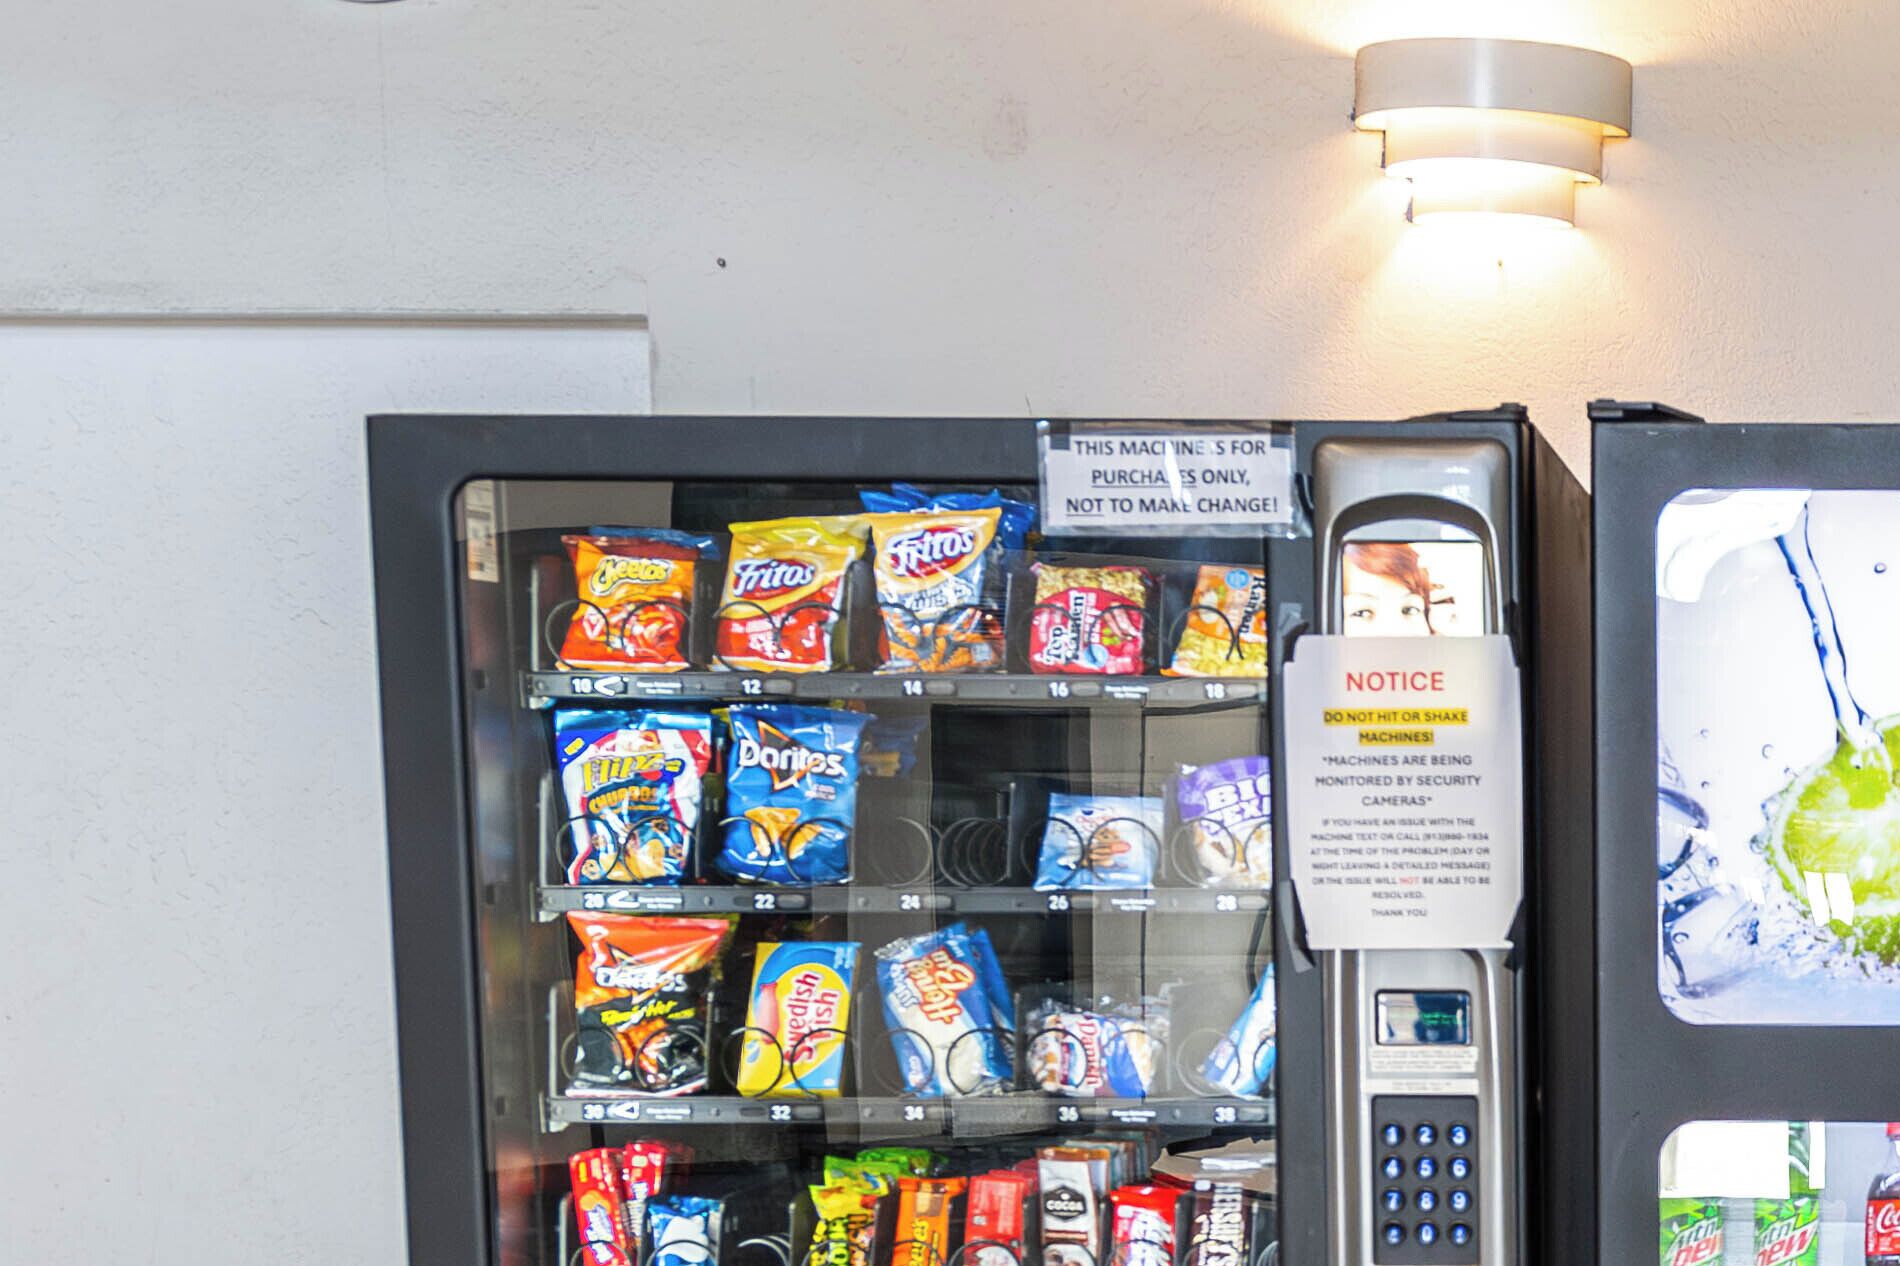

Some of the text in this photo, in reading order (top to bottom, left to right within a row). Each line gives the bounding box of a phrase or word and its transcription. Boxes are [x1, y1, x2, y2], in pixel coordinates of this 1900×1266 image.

[1075, 440, 1114, 455] THIS
[1231, 440, 1266, 455] FOR
[1092, 469, 1250, 486] PURCHAES ONLY,
[1066, 498, 1104, 513] NOT
[1111, 498, 1133, 512] TO
[1197, 498, 1278, 513] CHANGE!
[886, 527, 975, 577] Fritos
[592, 556, 671, 594] Cheetos
[733, 558, 815, 596] Fritos
[1346, 671, 1445, 692] NOTICE
[1049, 682, 1069, 698] 16
[1323, 711, 1468, 723] DO NOT HIT OR SHAKE
[1359, 732, 1433, 743] MACHINES!
[738, 738, 846, 777] Doritos
[1401, 755, 1427, 766] ARE
[1431, 755, 1473, 766] BEING
[1315, 776, 1481, 787] MONITORED BY SECURITY
[754, 894, 775, 909] 22
[784, 972, 821, 1062] Swedish
